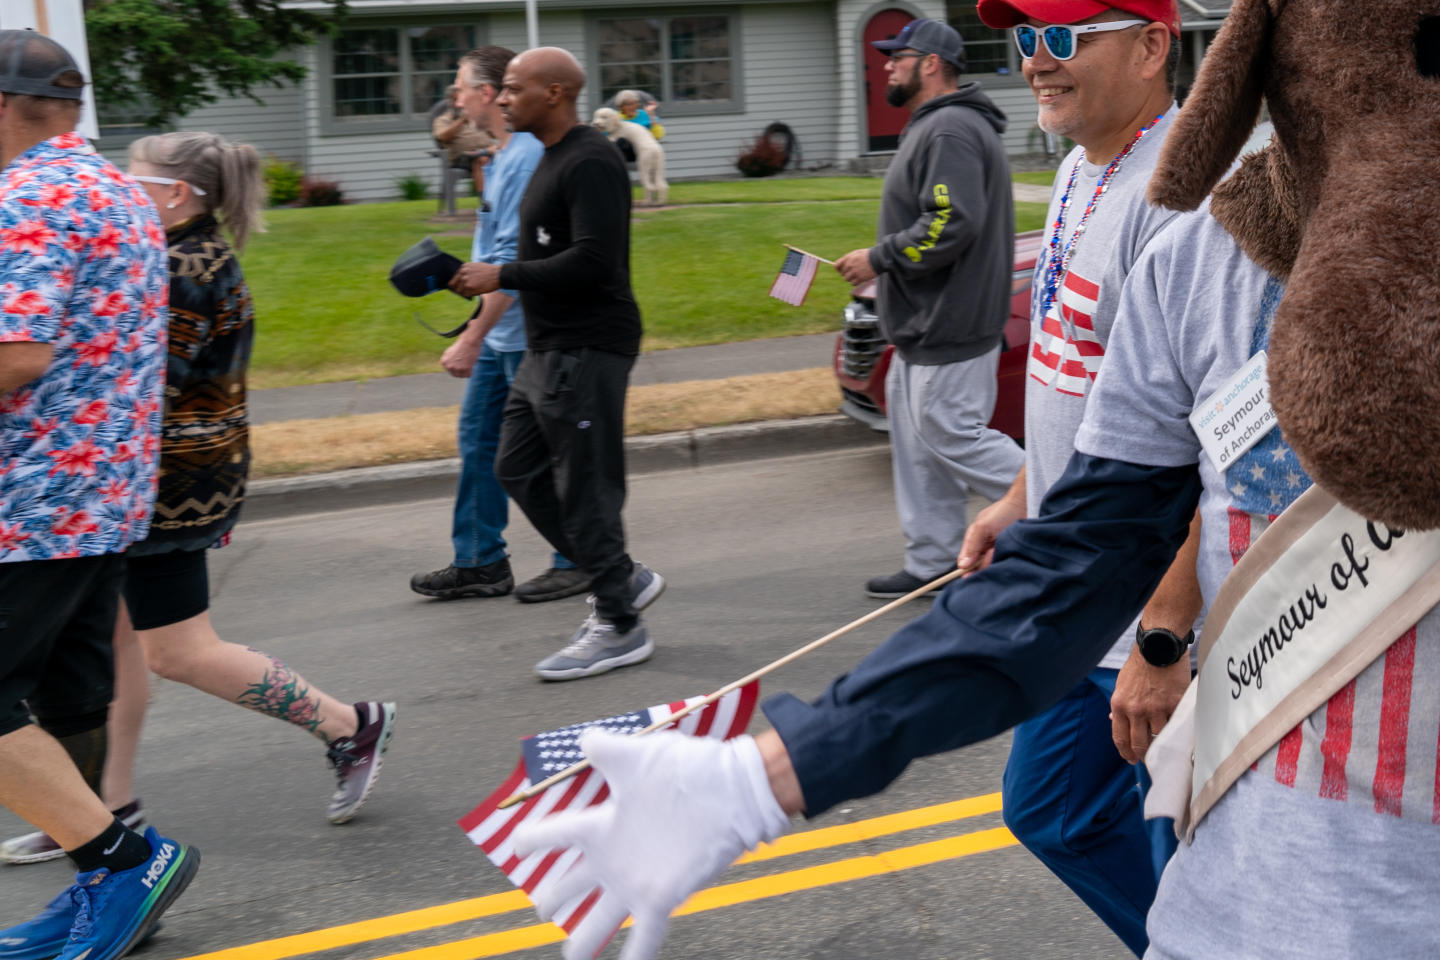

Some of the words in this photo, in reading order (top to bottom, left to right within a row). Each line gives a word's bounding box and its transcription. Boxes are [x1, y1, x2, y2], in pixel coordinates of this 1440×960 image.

[1224, 365, 1262, 406] anchorage
[1214, 388, 1265, 441] Seymour
[1219, 446, 1231, 463] of
[1232, 407, 1277, 453] Anchorag
[1226, 581, 1327, 700] Seymour
[1331, 534, 1369, 588] of
[141, 843, 175, 889] HOKA
